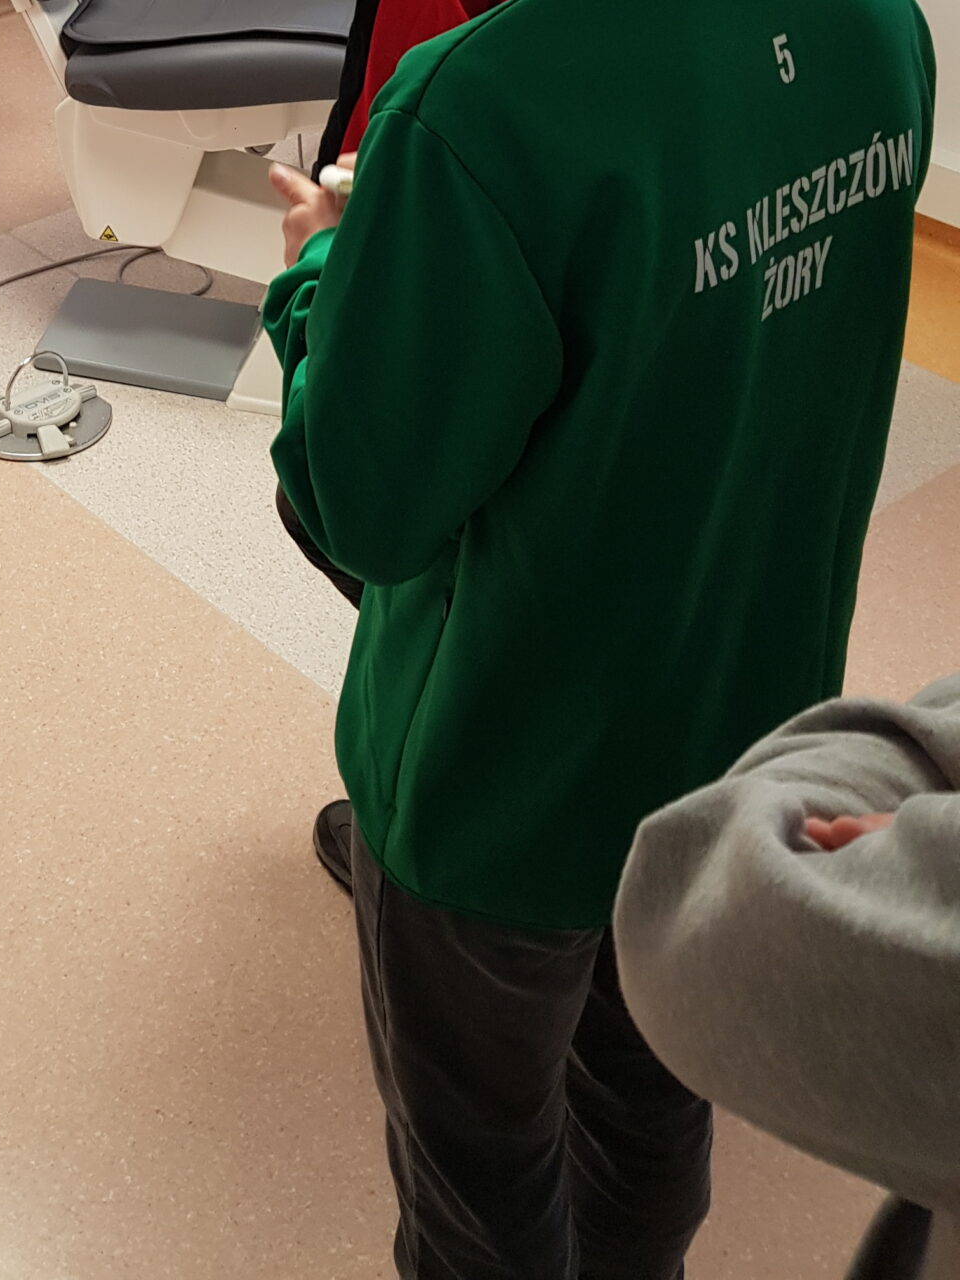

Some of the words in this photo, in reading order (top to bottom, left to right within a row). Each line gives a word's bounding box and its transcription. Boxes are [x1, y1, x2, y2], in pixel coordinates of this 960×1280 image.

[772, 33, 795, 84] 5
[694, 220, 739, 293] KS
[746, 129, 913, 265] KLESZCZÓW
[761, 236, 833, 322] ŻORY
